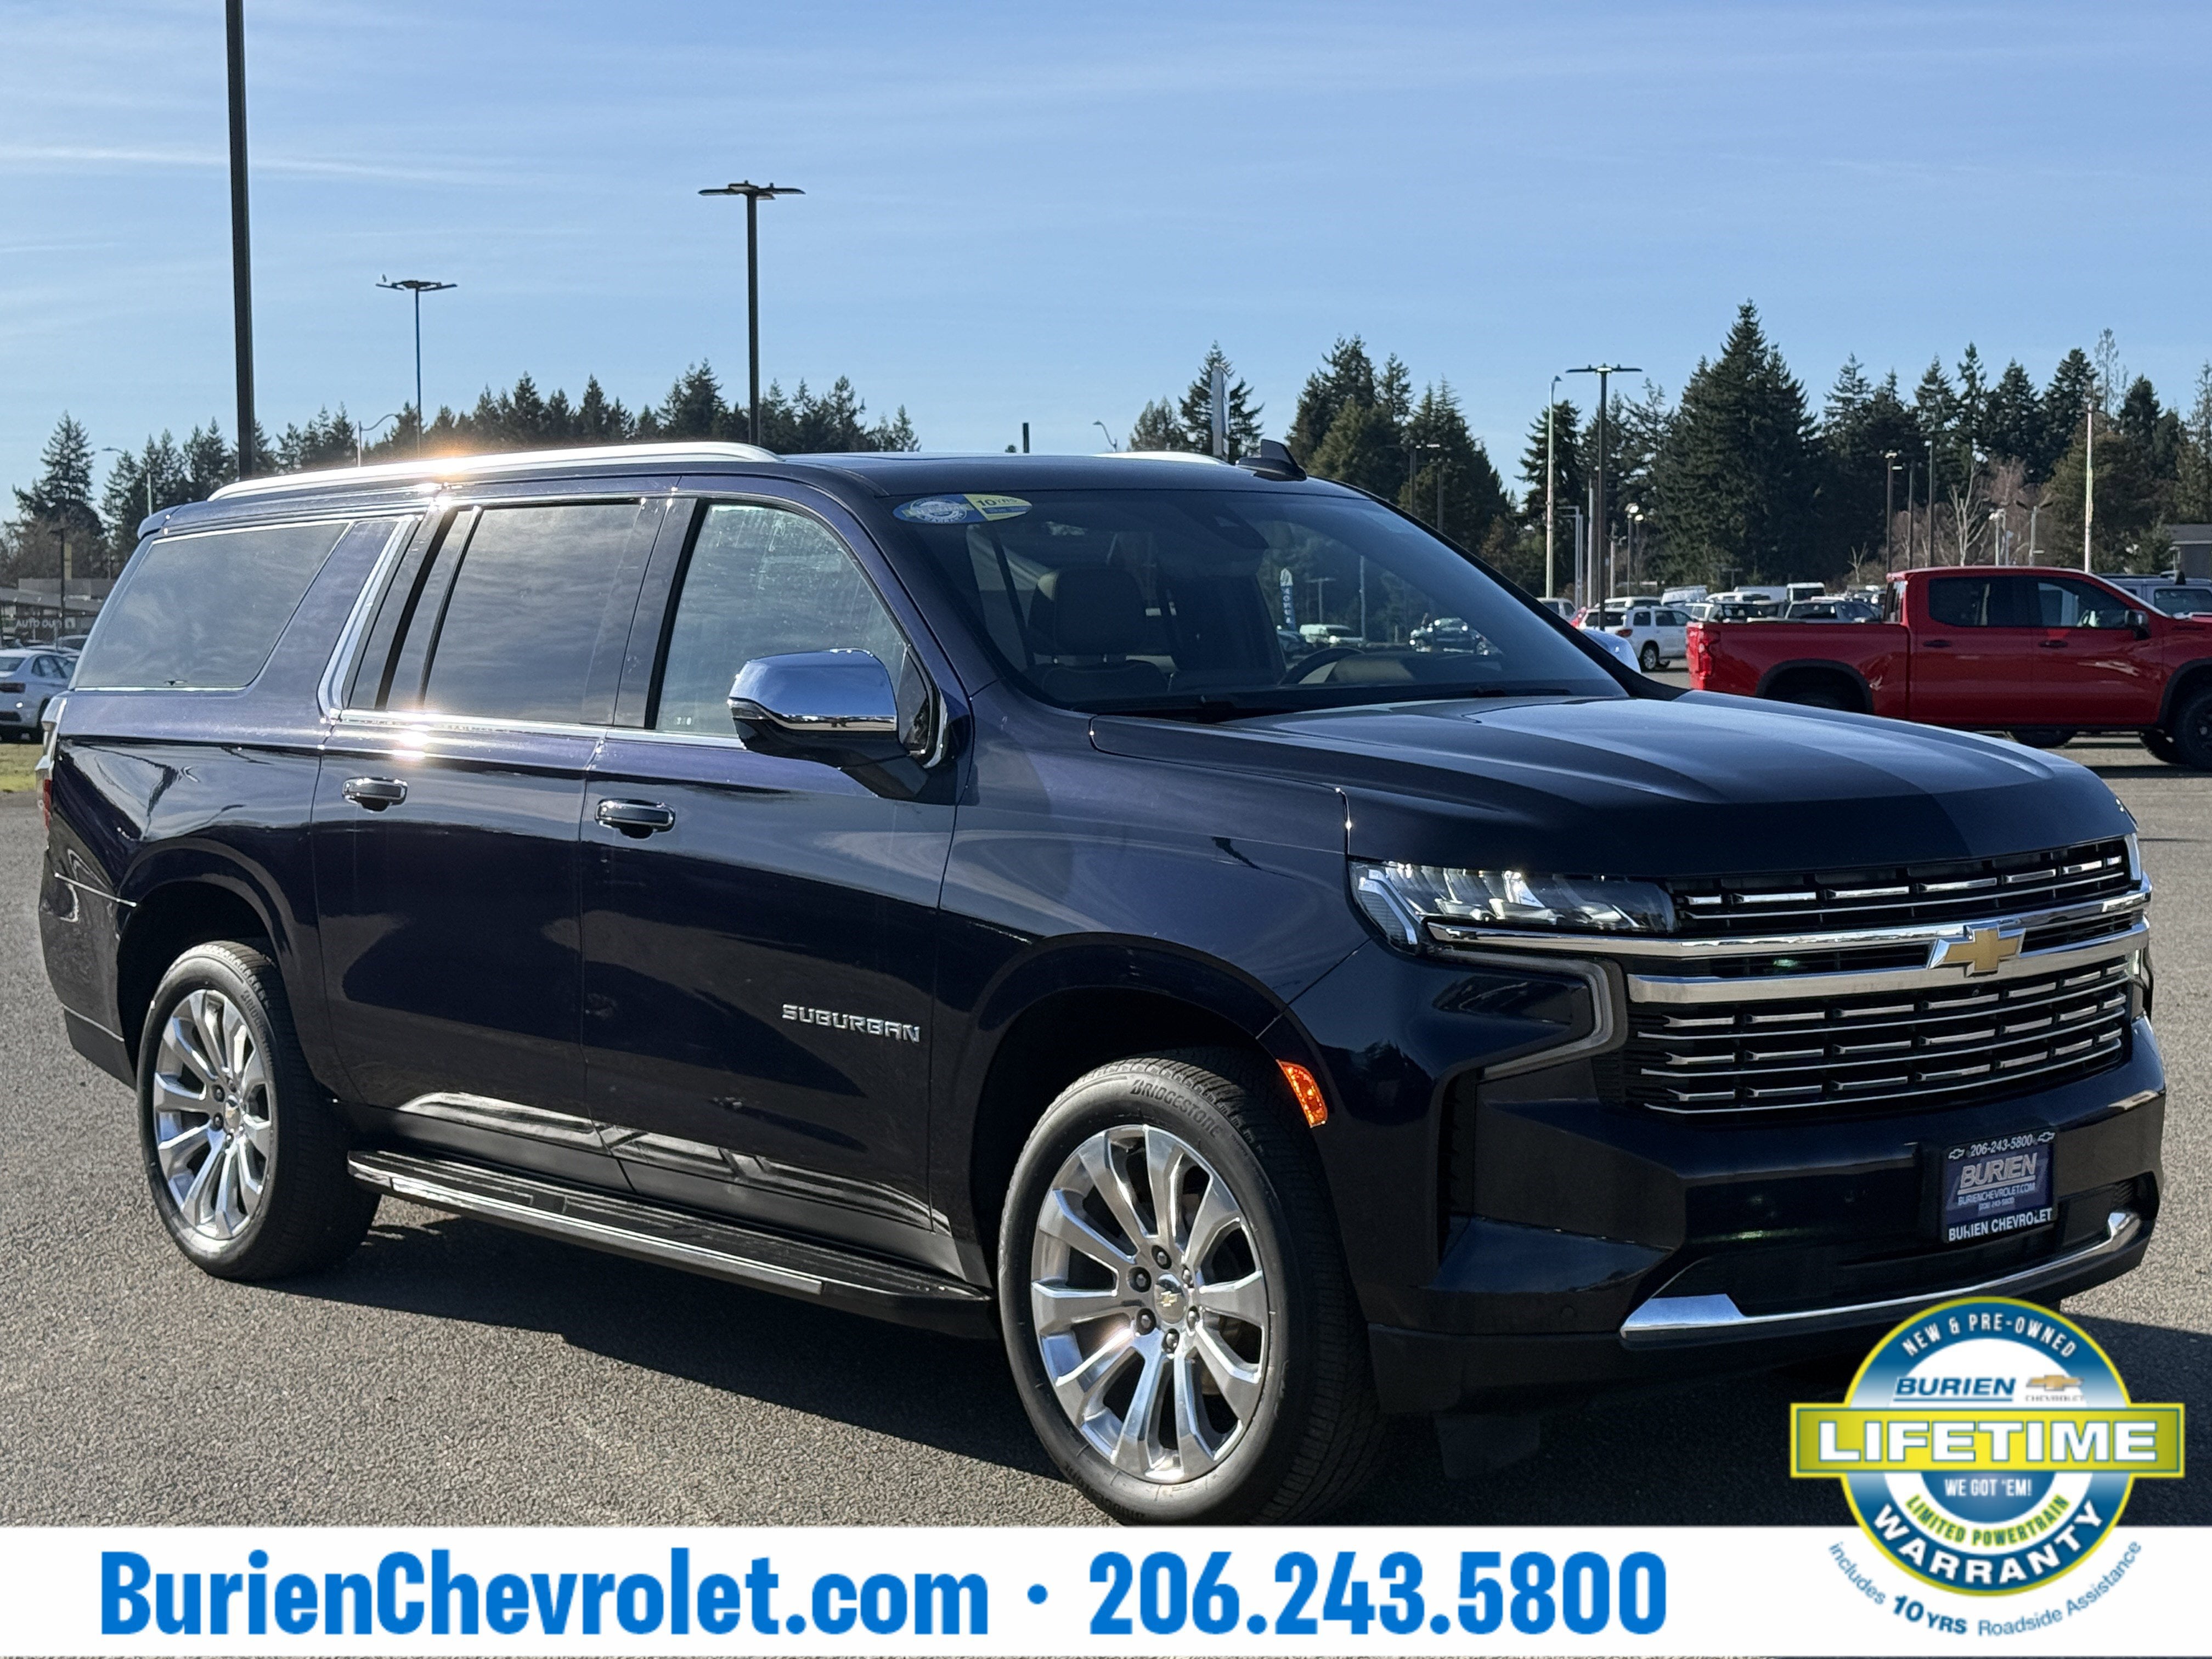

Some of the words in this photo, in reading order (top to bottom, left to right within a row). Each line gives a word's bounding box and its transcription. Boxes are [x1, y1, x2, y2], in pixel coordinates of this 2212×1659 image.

[782, 1004, 920, 1042] SUBURBAN
[1130, 1079, 1223, 1139] BRIDGESTONE
[1970, 1133, 2033, 1157] 206-243-5800
[1960, 1153, 2038, 1188] BURIEN
[1991, 1207, 2053, 1233] CHEVROLET
